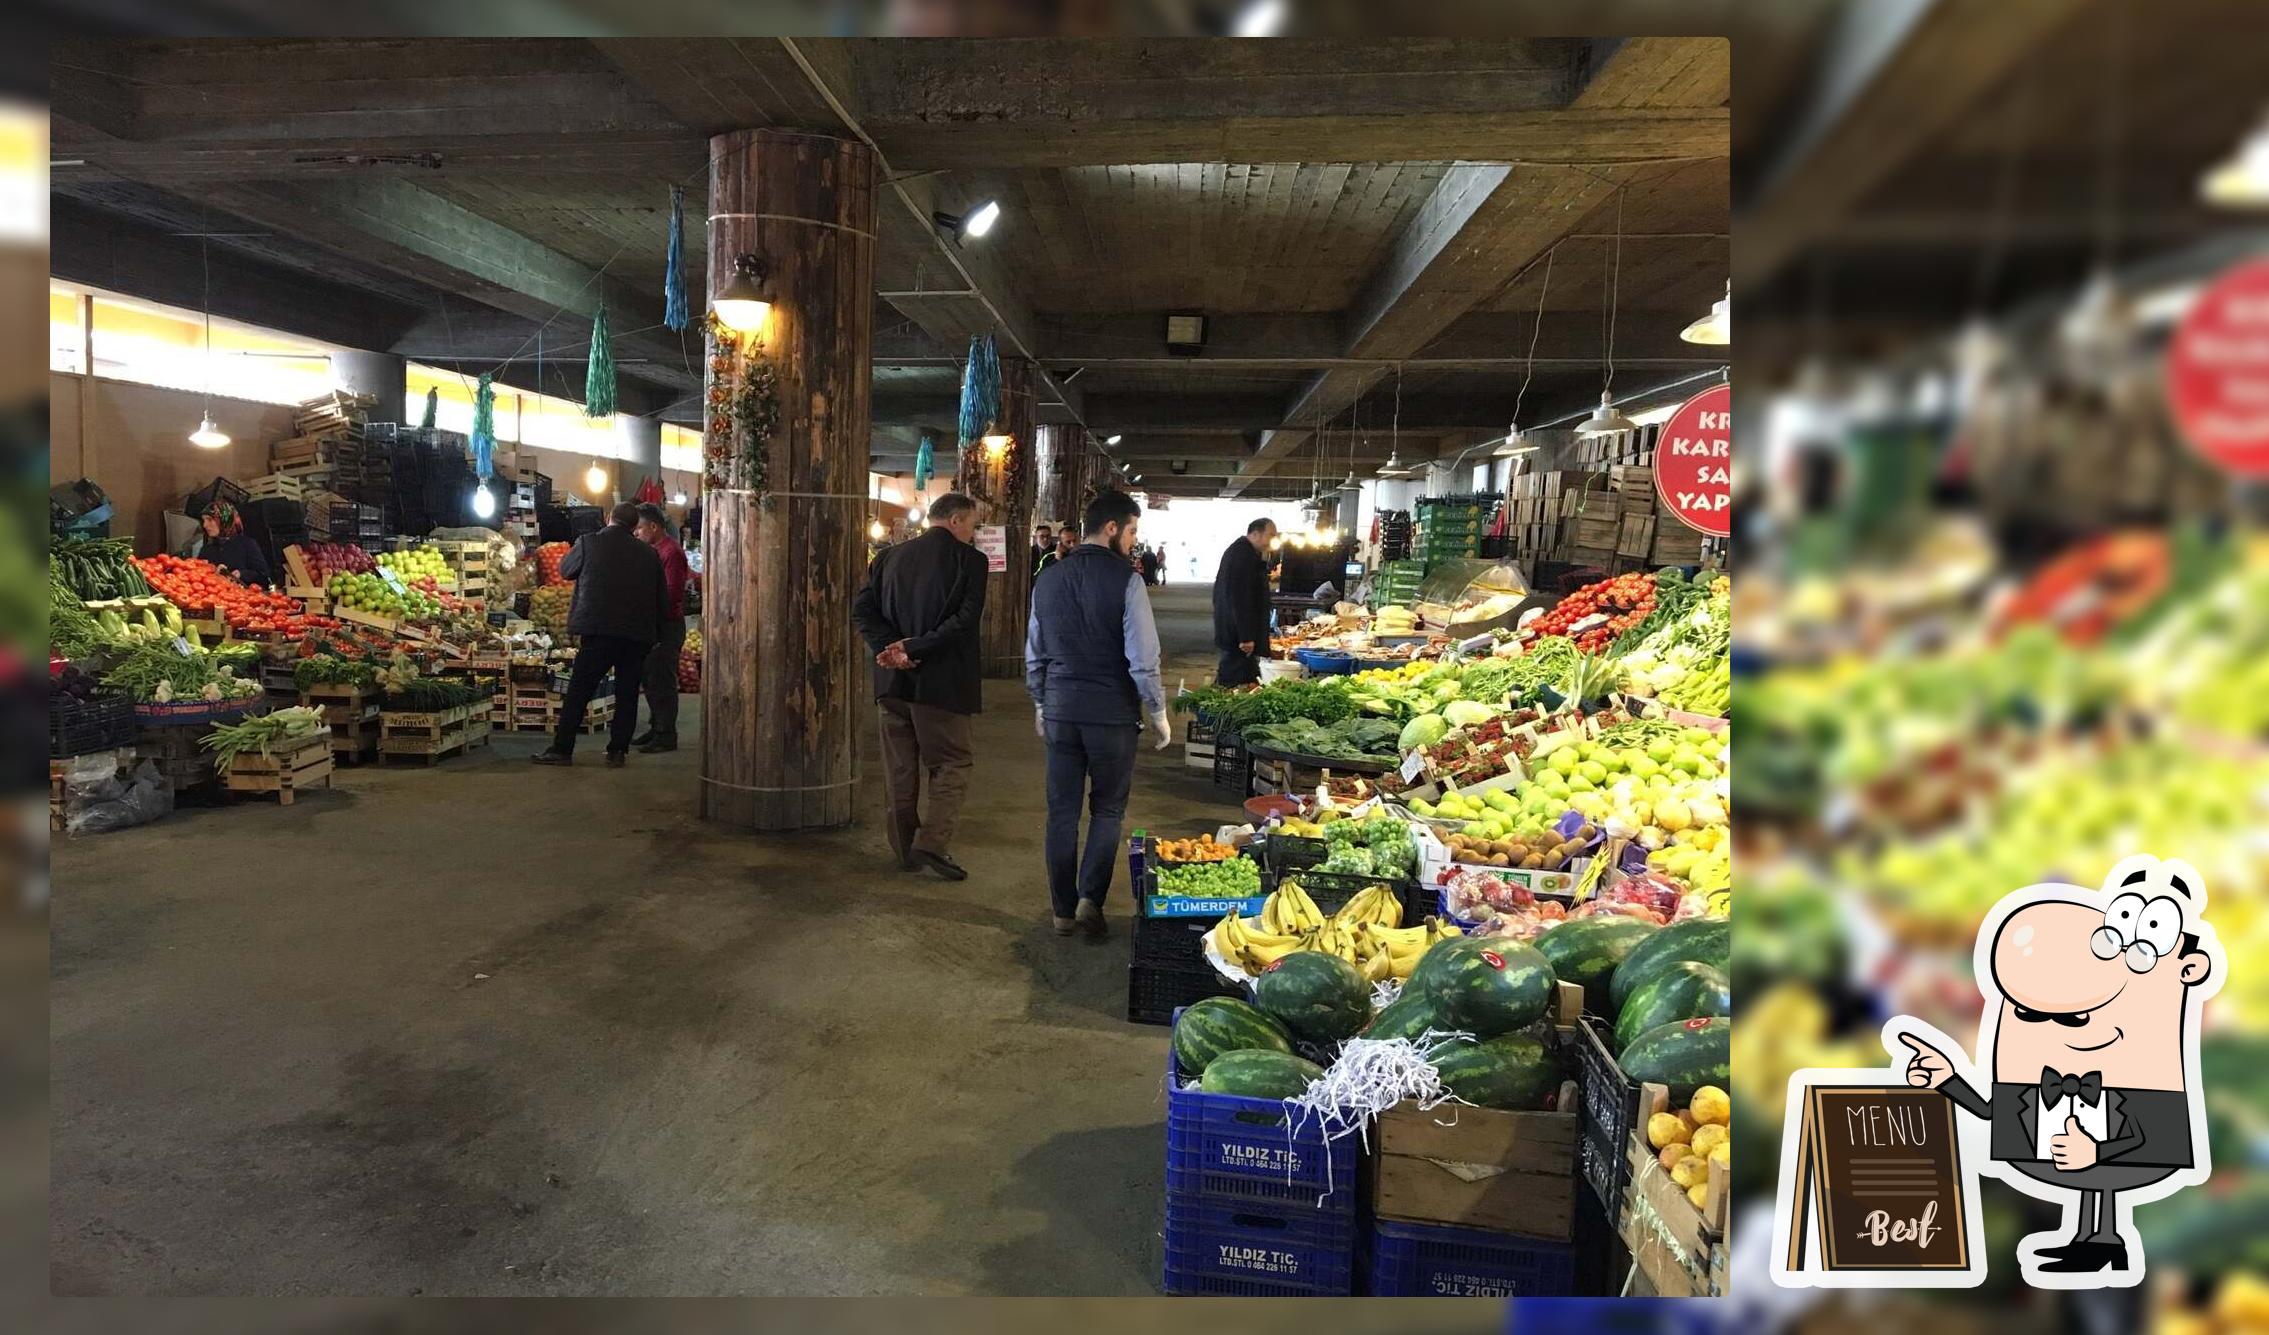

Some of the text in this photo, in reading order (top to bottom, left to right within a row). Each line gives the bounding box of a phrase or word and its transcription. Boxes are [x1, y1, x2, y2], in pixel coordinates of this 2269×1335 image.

[1672, 437, 1730, 457] KAR
[1697, 466, 1730, 485] SA
[1676, 491, 1730, 511] YAP
[1171, 899, 1248, 912] TÜMERDEM
[1221, 1143, 1270, 1160] YILDIZ
[1219, 1245, 1267, 1262] YILDIZ
[1247, 1261, 1252, 1269] 0
[1280, 1264, 1287, 1273] 11
